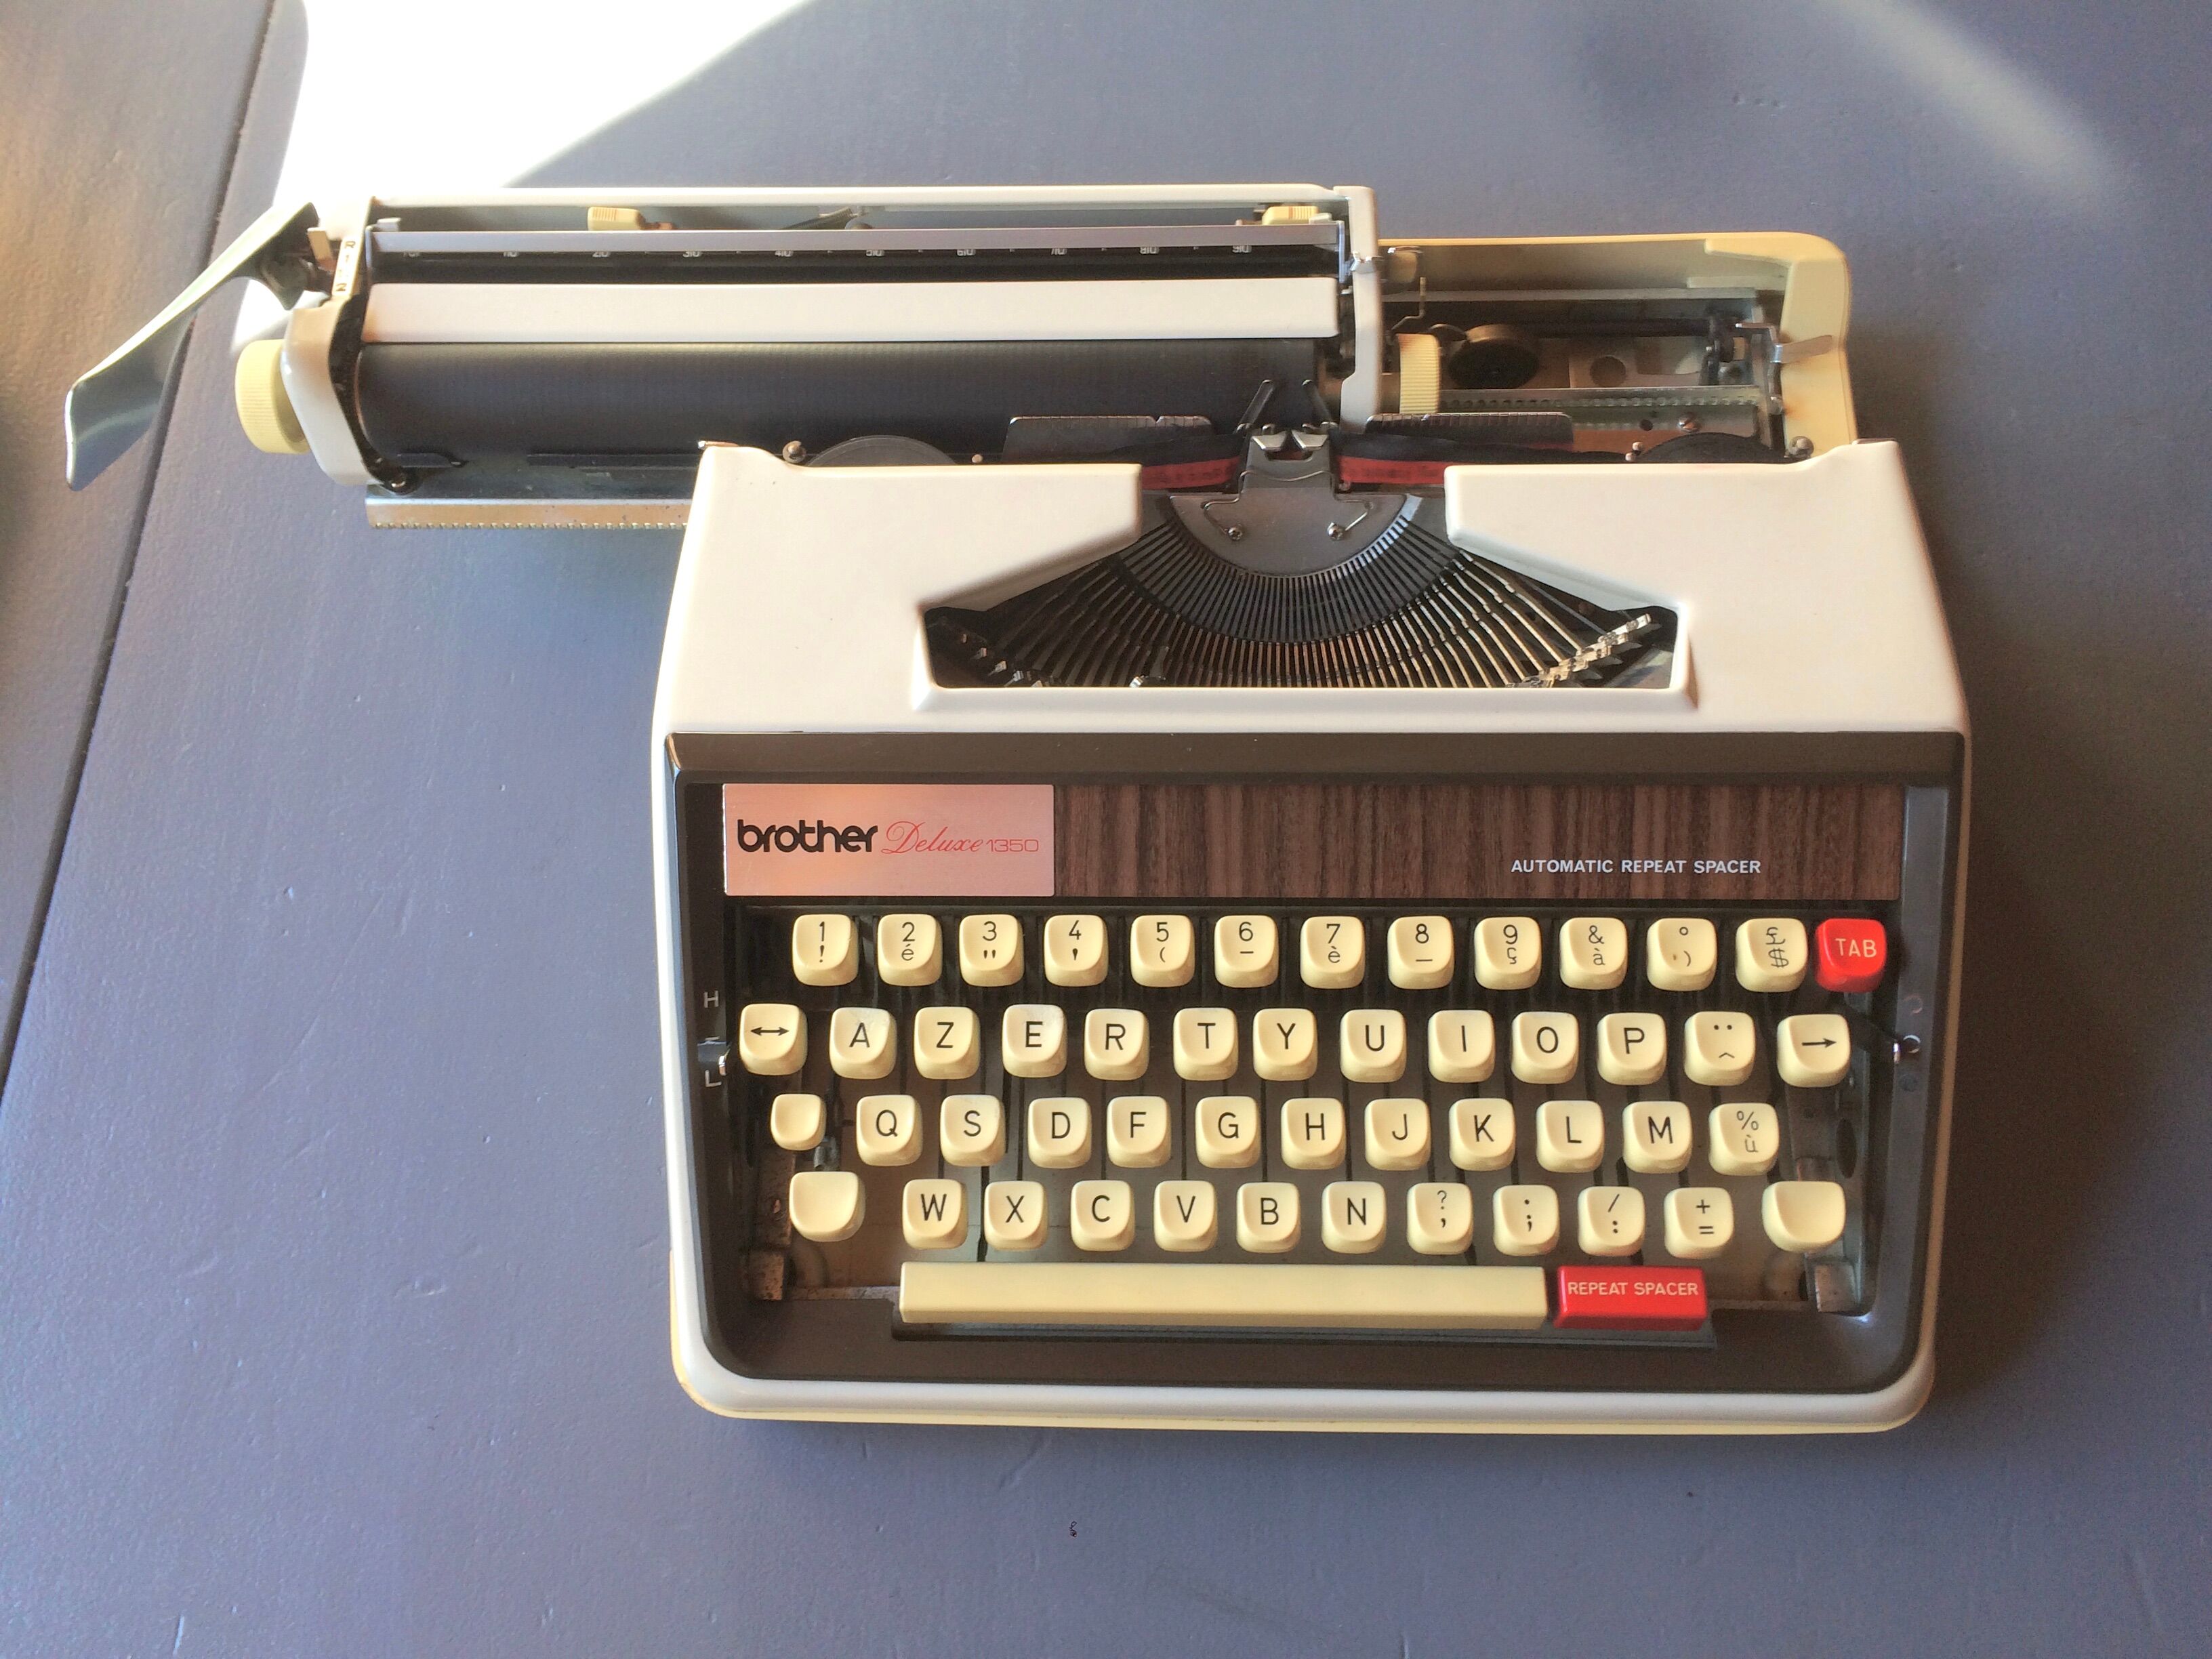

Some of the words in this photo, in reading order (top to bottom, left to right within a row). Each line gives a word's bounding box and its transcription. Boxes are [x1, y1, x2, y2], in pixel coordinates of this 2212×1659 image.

[737, 819, 878, 853] brother
[881, 820, 983, 854] Deluxe
[986, 839, 1040, 853] 1350
[1511, 859, 1614, 874] AUTOMATIC
[1621, 859, 1687, 874] REPEAT
[1694, 859, 1761, 874] SPACER
[819, 921, 825, 942] 1
[901, 921, 916, 942] 2
[982, 920, 997, 941] 3
[1068, 920, 1082, 941] 4
[1156, 921, 1169, 943] 5
[1239, 921, 1254, 942] 6
[1326, 923, 1341, 944] 7
[1415, 923, 1429, 944] 8
[1502, 924, 1518, 945] 9
[1588, 924, 1605, 945] &
[901, 943, 914, 962] é
[1328, 945, 1340, 964] è
[1593, 947, 1605, 966] à
[1767, 947, 1789, 968] $
[1835, 938, 1877, 958] TAB
[703, 990, 719, 1008] H
[848, 1022, 870, 1048] A
[936, 1021, 954, 1048] Z
[1025, 1021, 1044, 1048] E
[1105, 1023, 1126, 1050] R
[1197, 1022, 1216, 1049] T
[1276, 1023, 1296, 1050] Y
[1365, 1024, 1385, 1052] U
[1461, 1025, 1467, 1052] I
[1536, 1026, 1559, 1054] O
[1623, 1027, 1645, 1054] P
[705, 1069, 722, 1088] L
[876, 1109, 898, 1137] Q
[963, 1109, 981, 1137] S
[1051, 1111, 1071, 1139] D
[1130, 1111, 1147, 1139] F
[1218, 1111, 1240, 1139] G
[1305, 1112, 1326, 1141] H
[1391, 1113, 1408, 1141] J
[1473, 1114, 1494, 1142] K
[1565, 1115, 1582, 1144] L
[1647, 1115, 1673, 1144] M
[1736, 1110, 1759, 1131] %
[920, 1193, 947, 1222] W
[1005, 1195, 1025, 1223] X
[1091, 1195, 1111, 1223] C
[1176, 1195, 1196, 1223] V
[1260, 1197, 1279, 1225] B
[1347, 1197, 1367, 1226] N
[1568, 1282, 1628, 1295] REPEAT
[1634, 1282, 1699, 1296] SPACER
